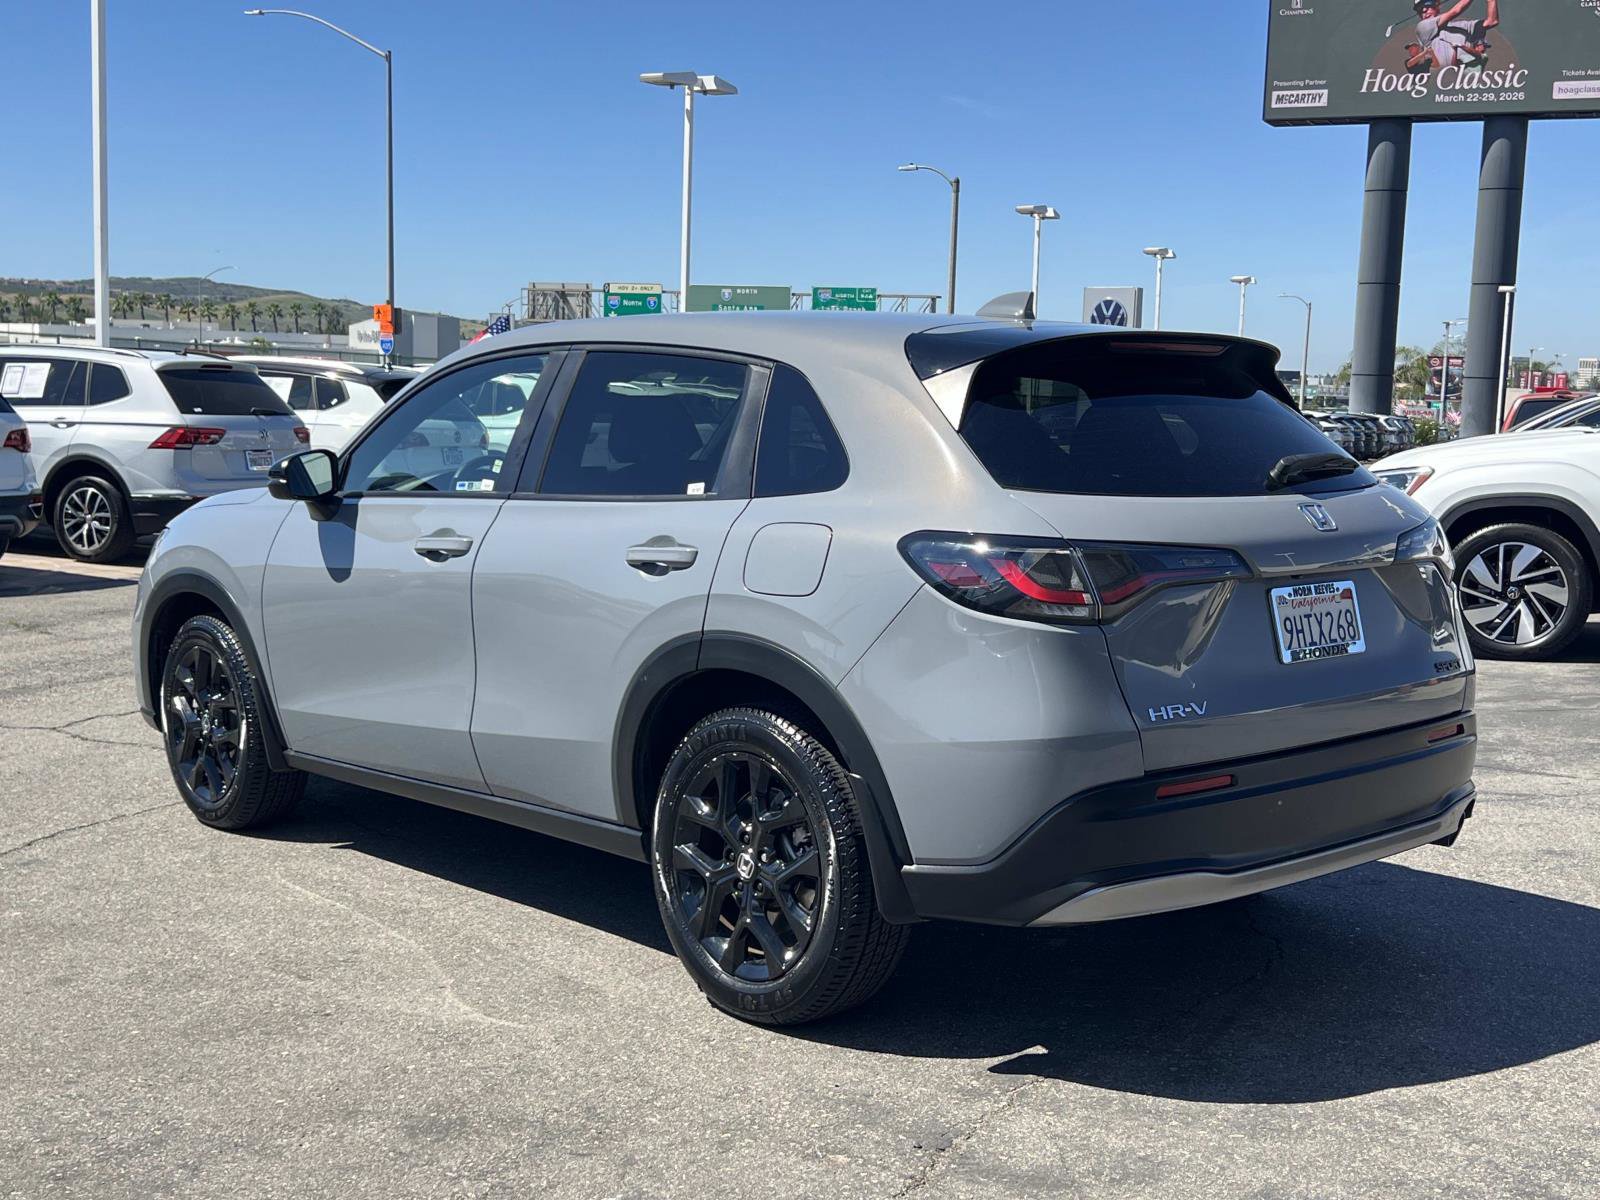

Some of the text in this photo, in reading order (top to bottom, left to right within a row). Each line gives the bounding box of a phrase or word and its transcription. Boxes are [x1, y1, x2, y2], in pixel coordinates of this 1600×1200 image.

[1360, 63, 1529, 98] Hoag Classic
[1435, 91, 1525, 103] March 22-29, 2026
[719, 304, 740, 312] Santa
[1292, 583, 1336, 598] NORM REEVES
[1284, 608, 1357, 651] 9HIX268
[1302, 642, 1349, 660] HONDA
[1148, 700, 1207, 722] HR-V
